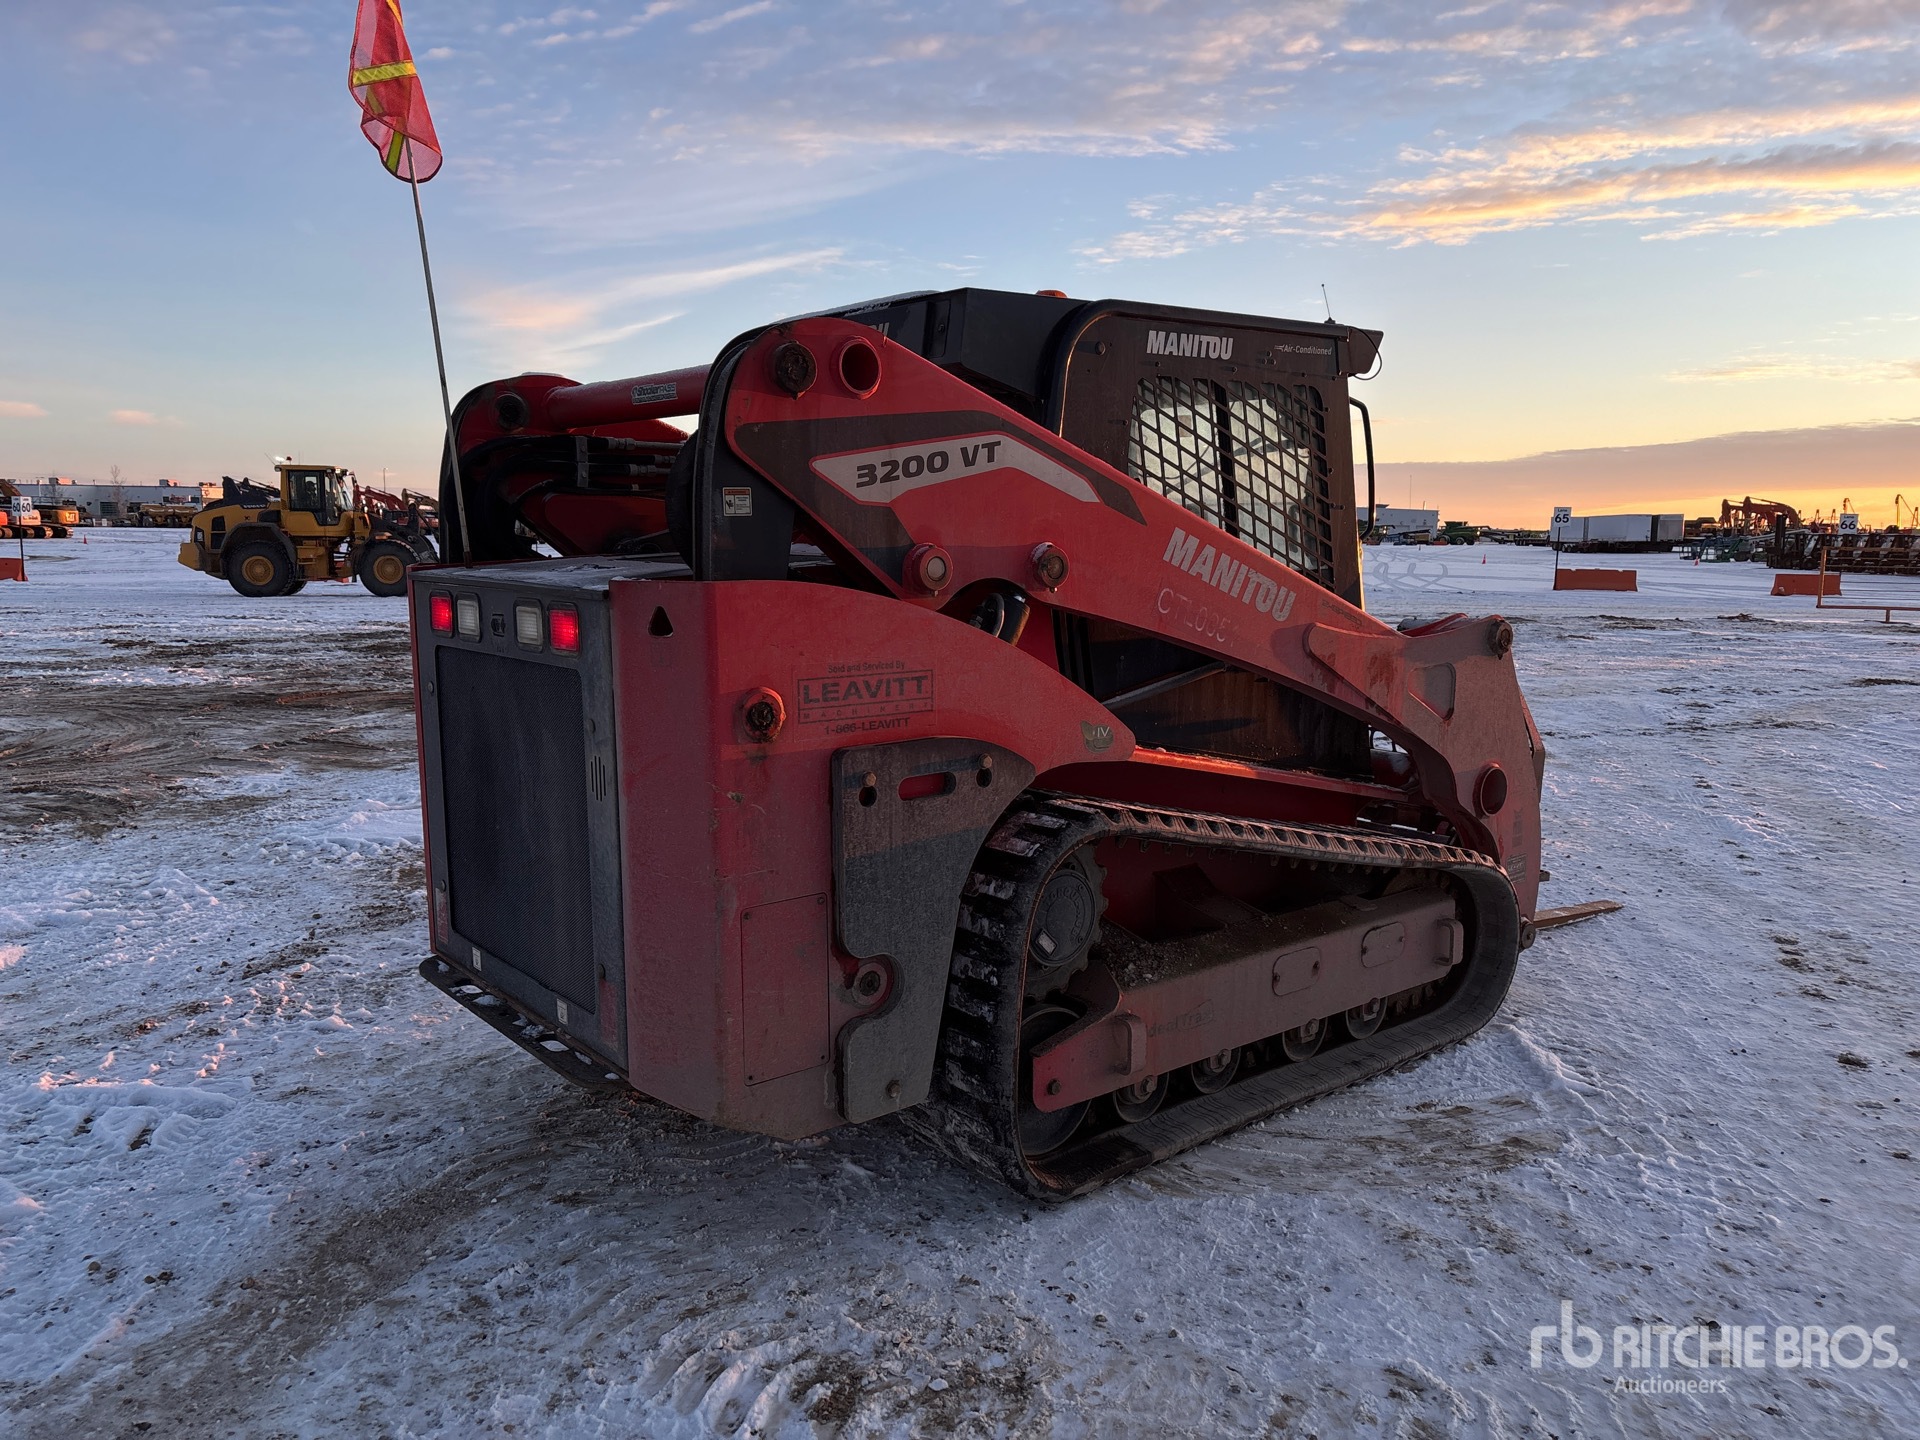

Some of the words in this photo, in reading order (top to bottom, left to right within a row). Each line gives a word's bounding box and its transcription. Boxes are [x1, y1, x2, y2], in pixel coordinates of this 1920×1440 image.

[1147, 330, 1233, 360] MANITOU
[1284, 345, 1332, 356] Air-Conditioned
[856, 451, 949, 488] 3200
[960, 441, 1001, 467] VT
[22, 503, 31, 512] 60
[1555, 514, 1569, 523] 65
[1841, 520, 1856, 530] 66
[1163, 527, 1296, 621] MANITOU
[828, 664, 845, 673] Sold
[847, 664, 860, 672] and
[862, 661, 894, 671] Serviced
[896, 660, 905, 670] By
[803, 675, 929, 704] LEAVITT
[825, 717, 910, 735] 1-866-LEAVITT
